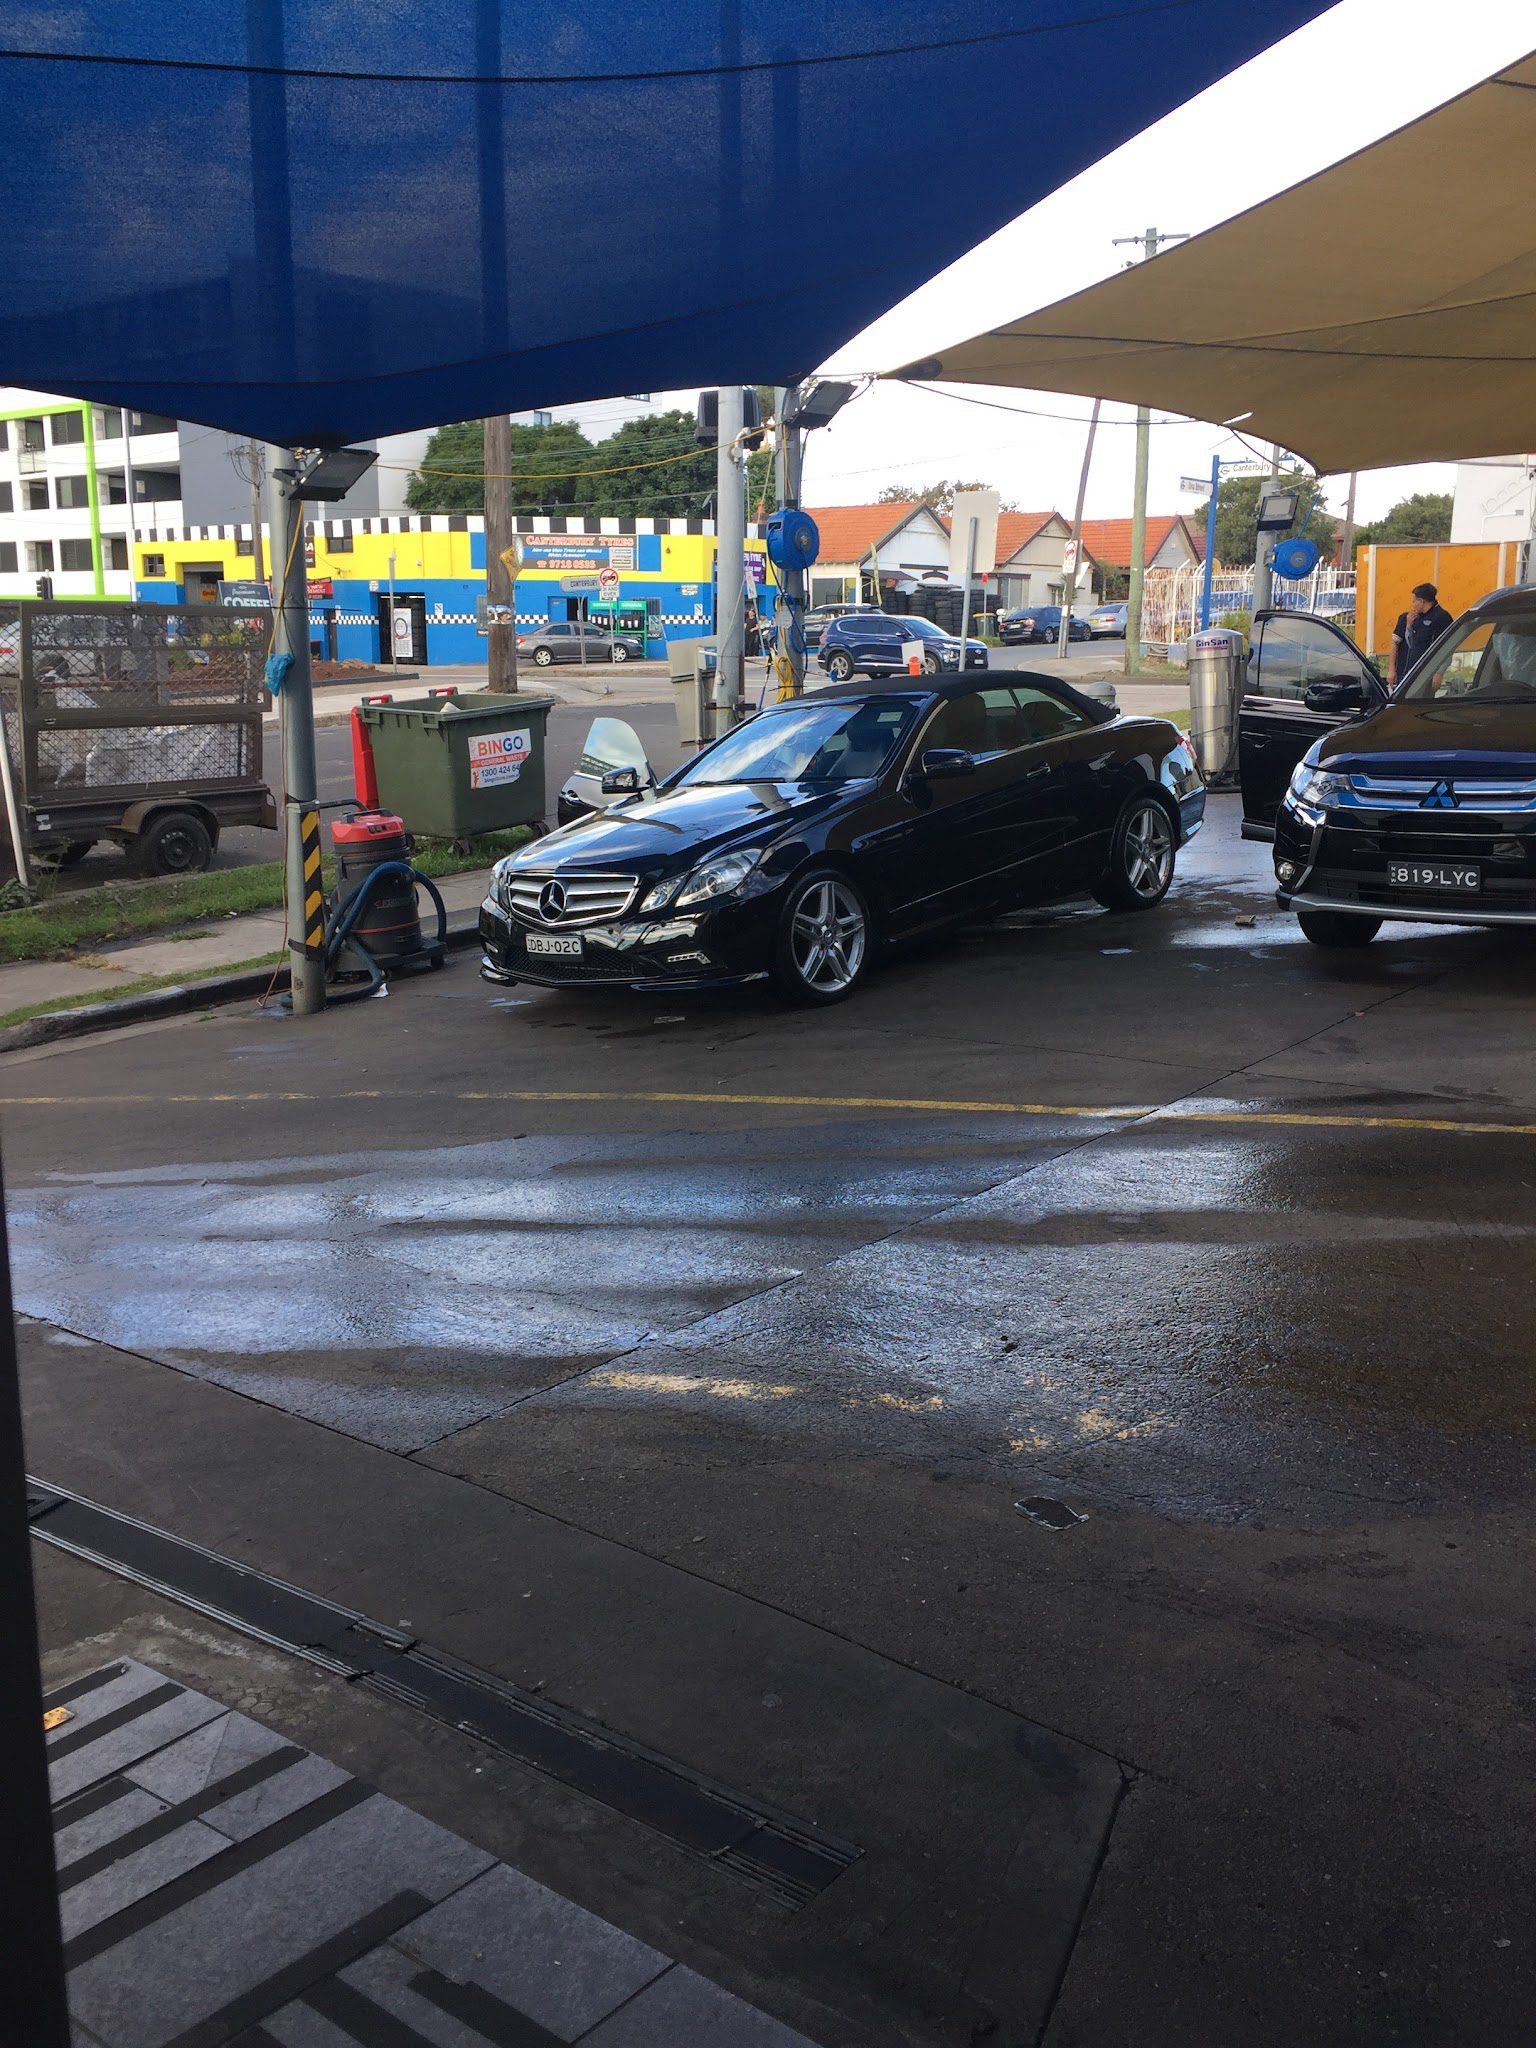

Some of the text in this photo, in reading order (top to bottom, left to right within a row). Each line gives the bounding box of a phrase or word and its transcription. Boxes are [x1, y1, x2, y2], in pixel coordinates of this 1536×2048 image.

[1232, 462, 1272, 472] Canterbury
[526, 535, 635, 546] CANTERBURY TYRES
[477, 736, 523, 756] BINGO
[481, 768, 497, 776] 1300
[499, 766, 511, 774] 424
